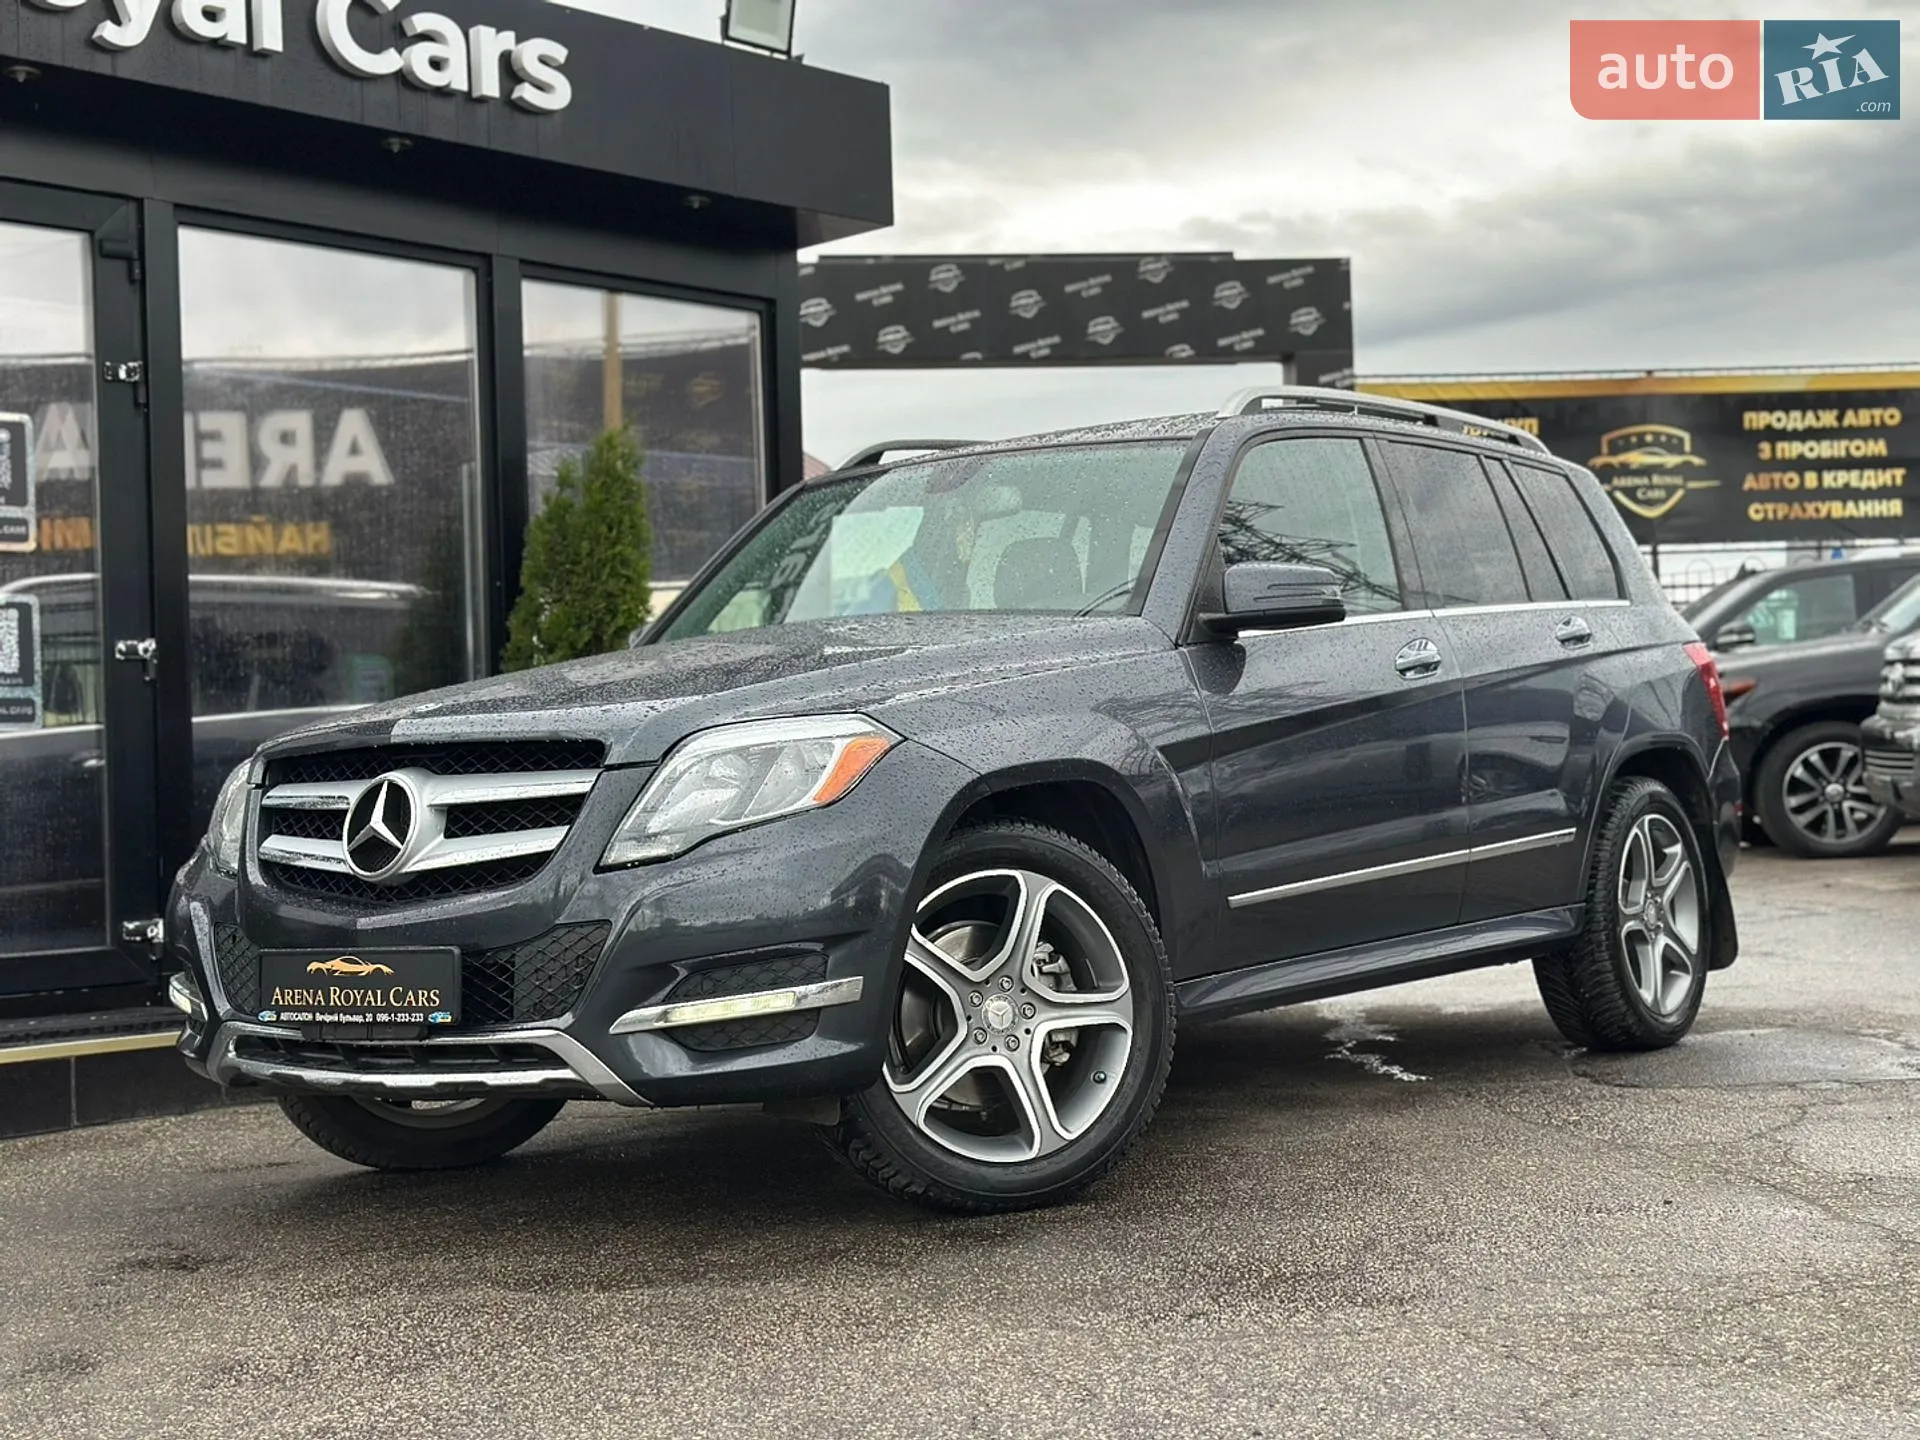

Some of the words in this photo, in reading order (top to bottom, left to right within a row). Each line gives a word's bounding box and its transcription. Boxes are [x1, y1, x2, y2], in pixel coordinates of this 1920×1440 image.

[316, 0, 572, 112] Cars
[1742, 410, 1839, 431] ПРОДАЖ
[1842, 407, 1902, 427] АВТО
[1775, 438, 1888, 460] ПРОБІГОМ
[1742, 471, 1800, 491] АВТО
[1803, 470, 1818, 489] В
[1821, 467, 1906, 490] КРЕДИТ
[1748, 498, 1903, 521] СТРАХУВАННЯ
[271, 986, 325, 1006] ARENA
[329, 986, 387, 1007] ROYAL
[389, 986, 440, 1007] CARS
